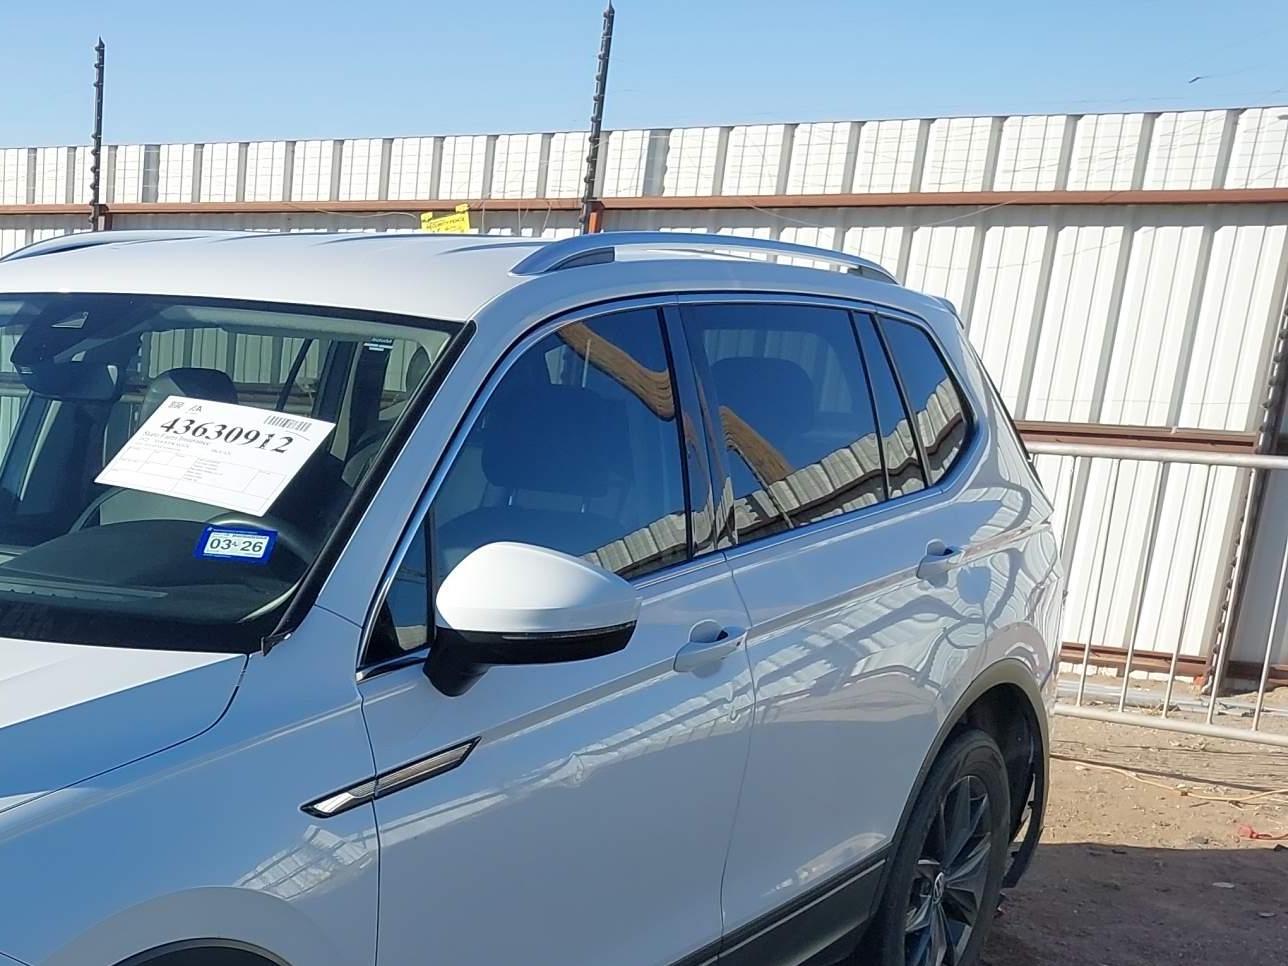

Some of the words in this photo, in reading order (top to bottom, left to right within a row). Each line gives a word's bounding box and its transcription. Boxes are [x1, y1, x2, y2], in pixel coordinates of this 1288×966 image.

[160, 416, 294, 454] 43630912
[210, 538, 233, 550] 03
[240, 540, 264, 553] 26
